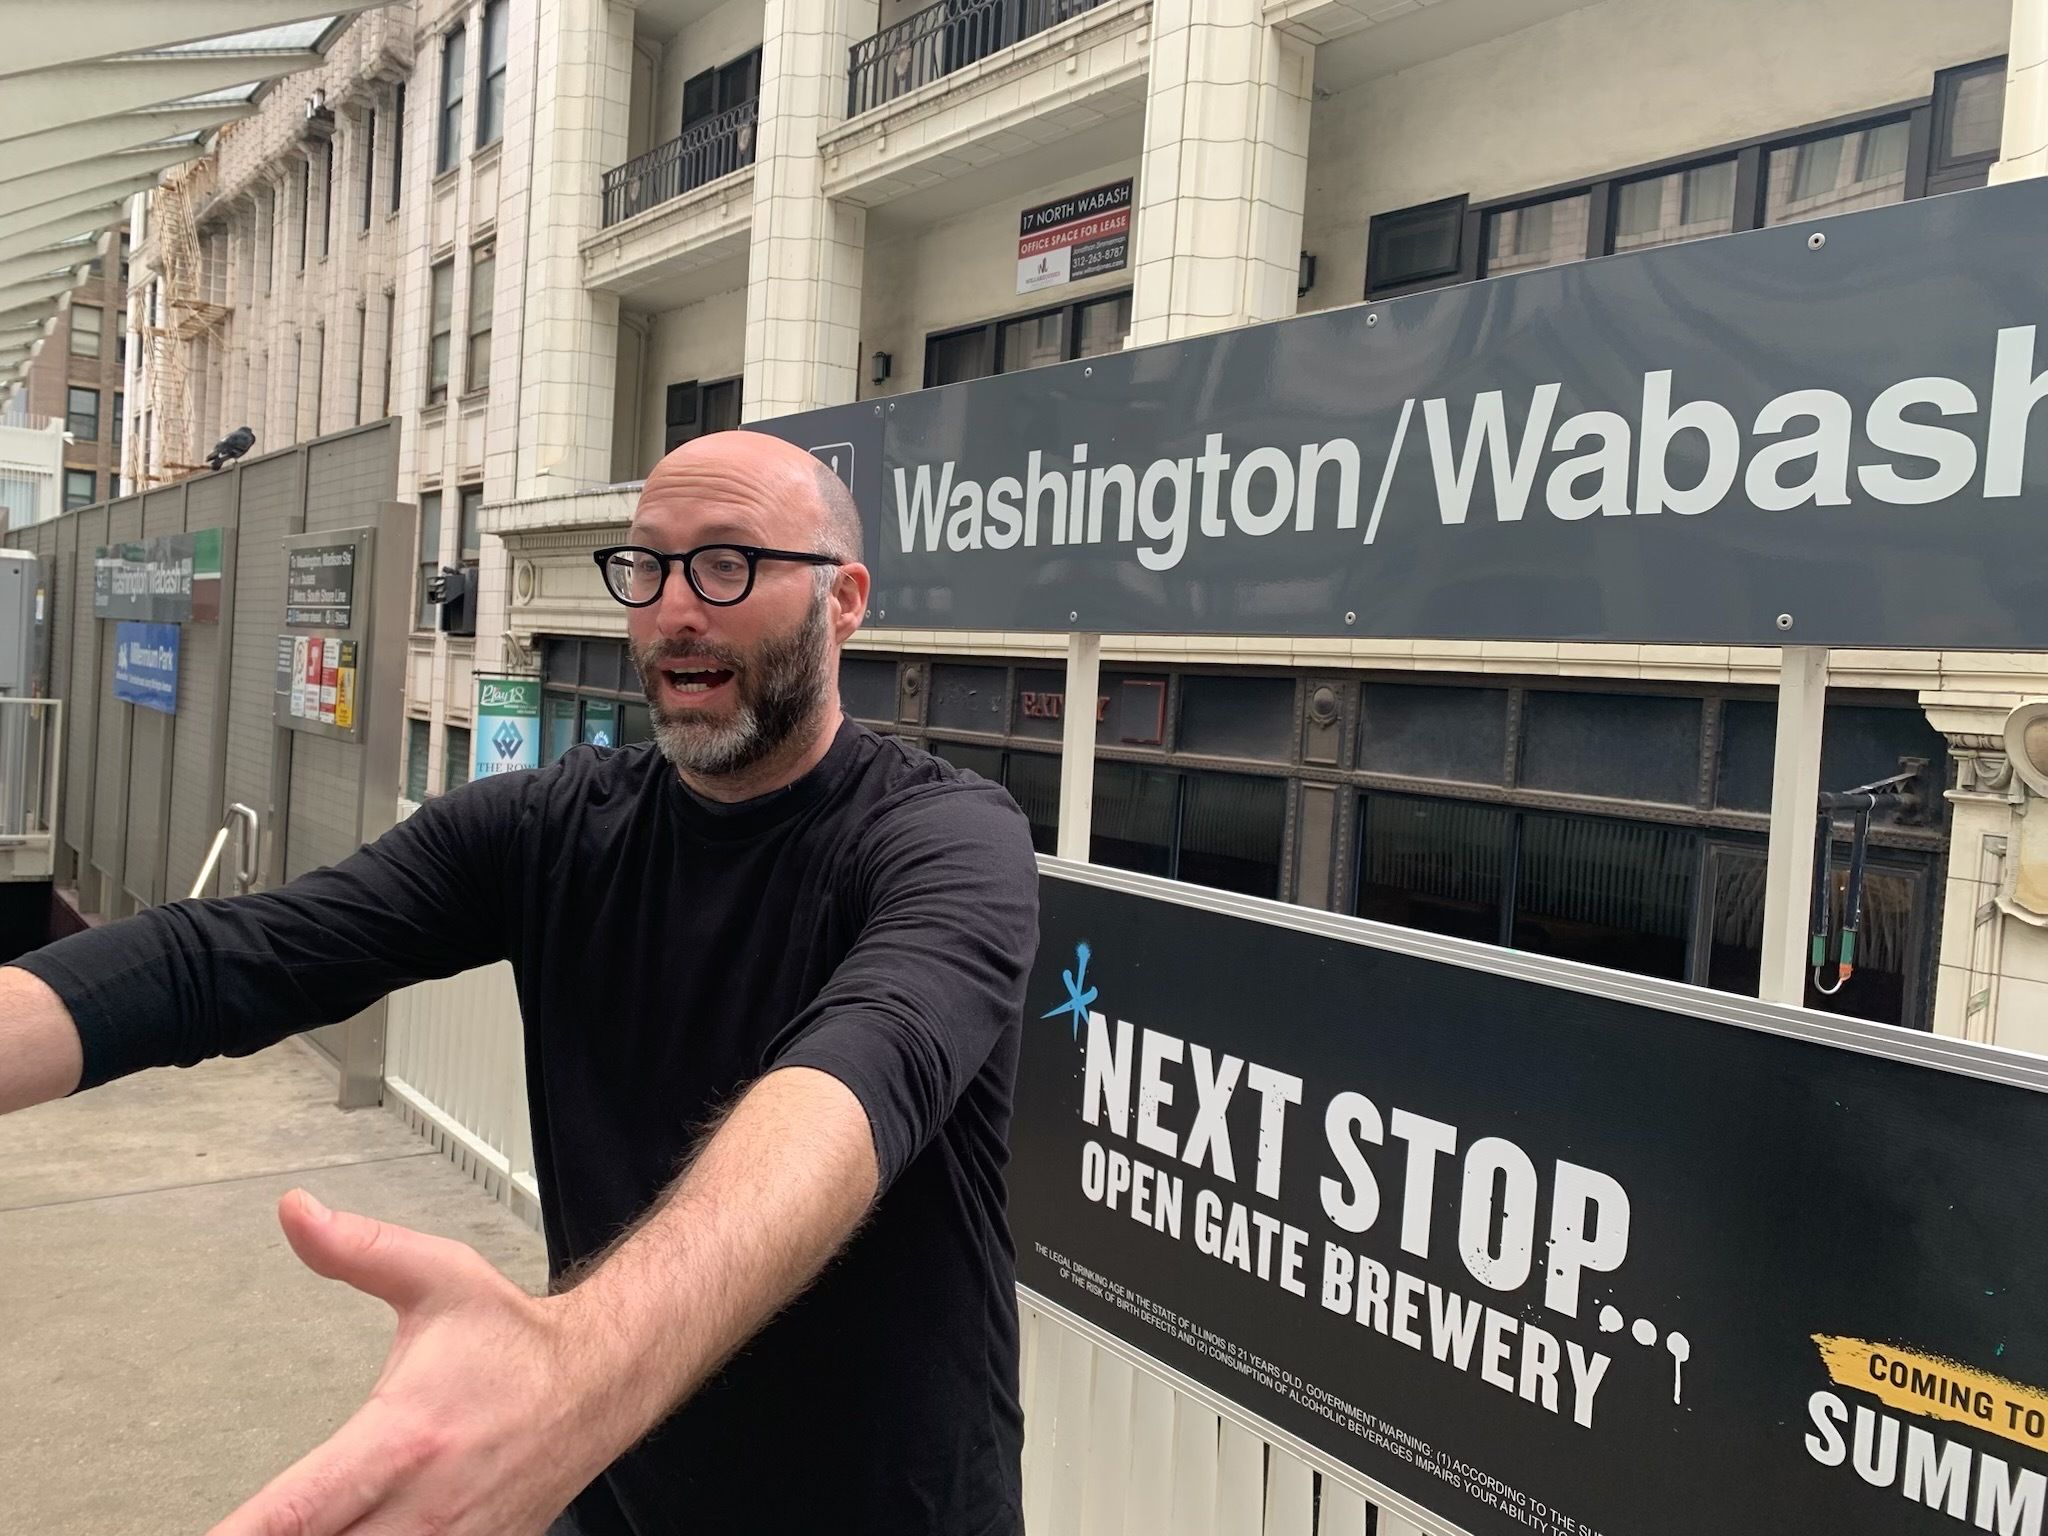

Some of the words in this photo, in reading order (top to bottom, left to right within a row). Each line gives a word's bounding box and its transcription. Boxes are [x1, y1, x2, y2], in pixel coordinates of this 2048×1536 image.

[1021, 238, 1049, 254] OFFICE
[1052, 229, 1078, 245] SPACE
[1081, 224, 1097, 238] FOR
[1100, 215, 1127, 232] LEASE
[1023, 214, 1034, 230] 17
[1036, 202, 1075, 226] NORTH
[1078, 186, 1129, 213] WABASH
[1073, 246, 1124, 268] 312-263-8787
[1021, 691, 1110, 721] EATY
[477, 762, 503, 773] THE
[1082, 1011, 1303, 1200] NEXT
[1082, 1141, 1183, 1239] OPEN
[1195, 1190, 1308, 1297] GATE
[1322, 1241, 1611, 1428] BREWERY
[1035, 1241, 1048, 1257] THE
[1049, 1249, 1071, 1270] LEGAL
[1073, 1262, 1108, 1288] DRINKING
[1109, 1279, 1125, 1297] AGE
[1126, 1288, 1134, 1302] IN
[1136, 1293, 1150, 1310] THE
[1152, 1302, 1176, 1325] STATE
[1178, 1316, 1189, 1329] OF
[1191, 1322, 1226, 1349] ILLINOIS
[1228, 1341, 1236, 1354] IS
[1238, 1347, 1248, 1361] 21
[1249, 1353, 1280, 1378] YEARS
[1282, 1370, 1304, 1391] OLD.
[1306, 1384, 1378, 1428] GOVERNMENT
[1379, 1420, 1433, 1458] WARNING:
[1436, 1451, 1451, 1469] (1)
[1452, 1459, 1526, 1507] ACCORDING
[1529, 1497, 1547, 1517] TO
[1550, 1508, 1575, 1533] THE
[1059, 1267, 1069, 1280] OF
[1071, 1273, 1085, 1289] THE
[1086, 1280, 1103, 1297] RISK
[1105, 1290, 1116, 1303] OF
[1117, 1297, 1140, 1317] BIRTH
[1141, 1309, 1177, 1337] DEFECTS
[1177, 1329, 1195, 1347] AND
[1197, 1339, 1208, 1356] (2)
[1208, 1346, 1273, 1390] CONSUMPTION
[1274, 1380, 1288, 1395] OF
[1289, 1390, 1346, 1427] ALCOHOLIC
[1348, 1420, 1413, 1463] BEVERAGES
[1415, 1454, 1461, 1488] IMPAIRS
[1463, 1480, 1498, 1509] YOUR
[1500, 1500, 1548, 1534] ABILITY
[1869, 1354, 1993, 1422] COMING
[2005, 1401, 2046, 1438] TO
[1805, 1391, 2048, 1536] SUMM
